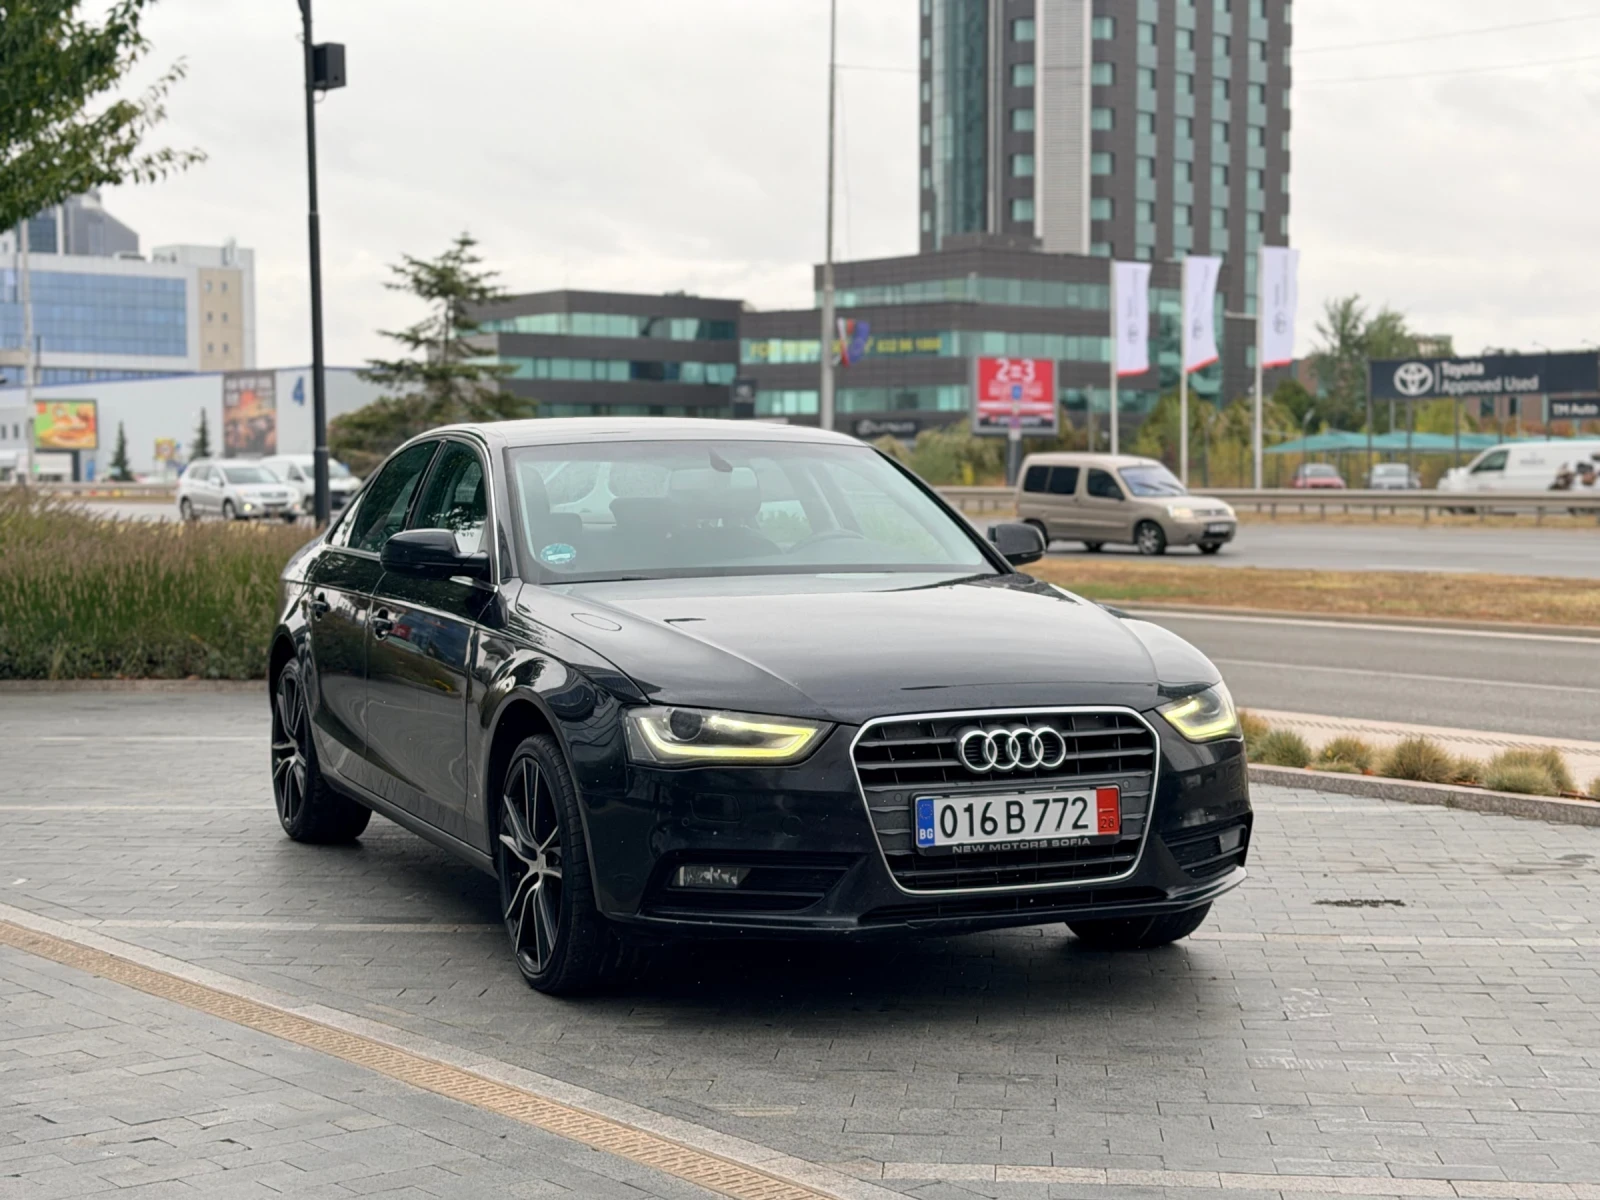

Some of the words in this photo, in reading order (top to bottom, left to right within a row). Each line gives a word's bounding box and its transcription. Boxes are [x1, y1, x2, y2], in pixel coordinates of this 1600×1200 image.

[1441, 361, 1485, 378] Toyota
[292, 376, 305, 407] 4
[1442, 377, 1502, 393] Approved
[1504, 375, 1540, 391] Used
[919, 828, 934, 840] BG
[952, 844, 985, 853] NEW
[989, 840, 1048, 851] MOTORS
[1051, 837, 1091, 847] SOFIA
